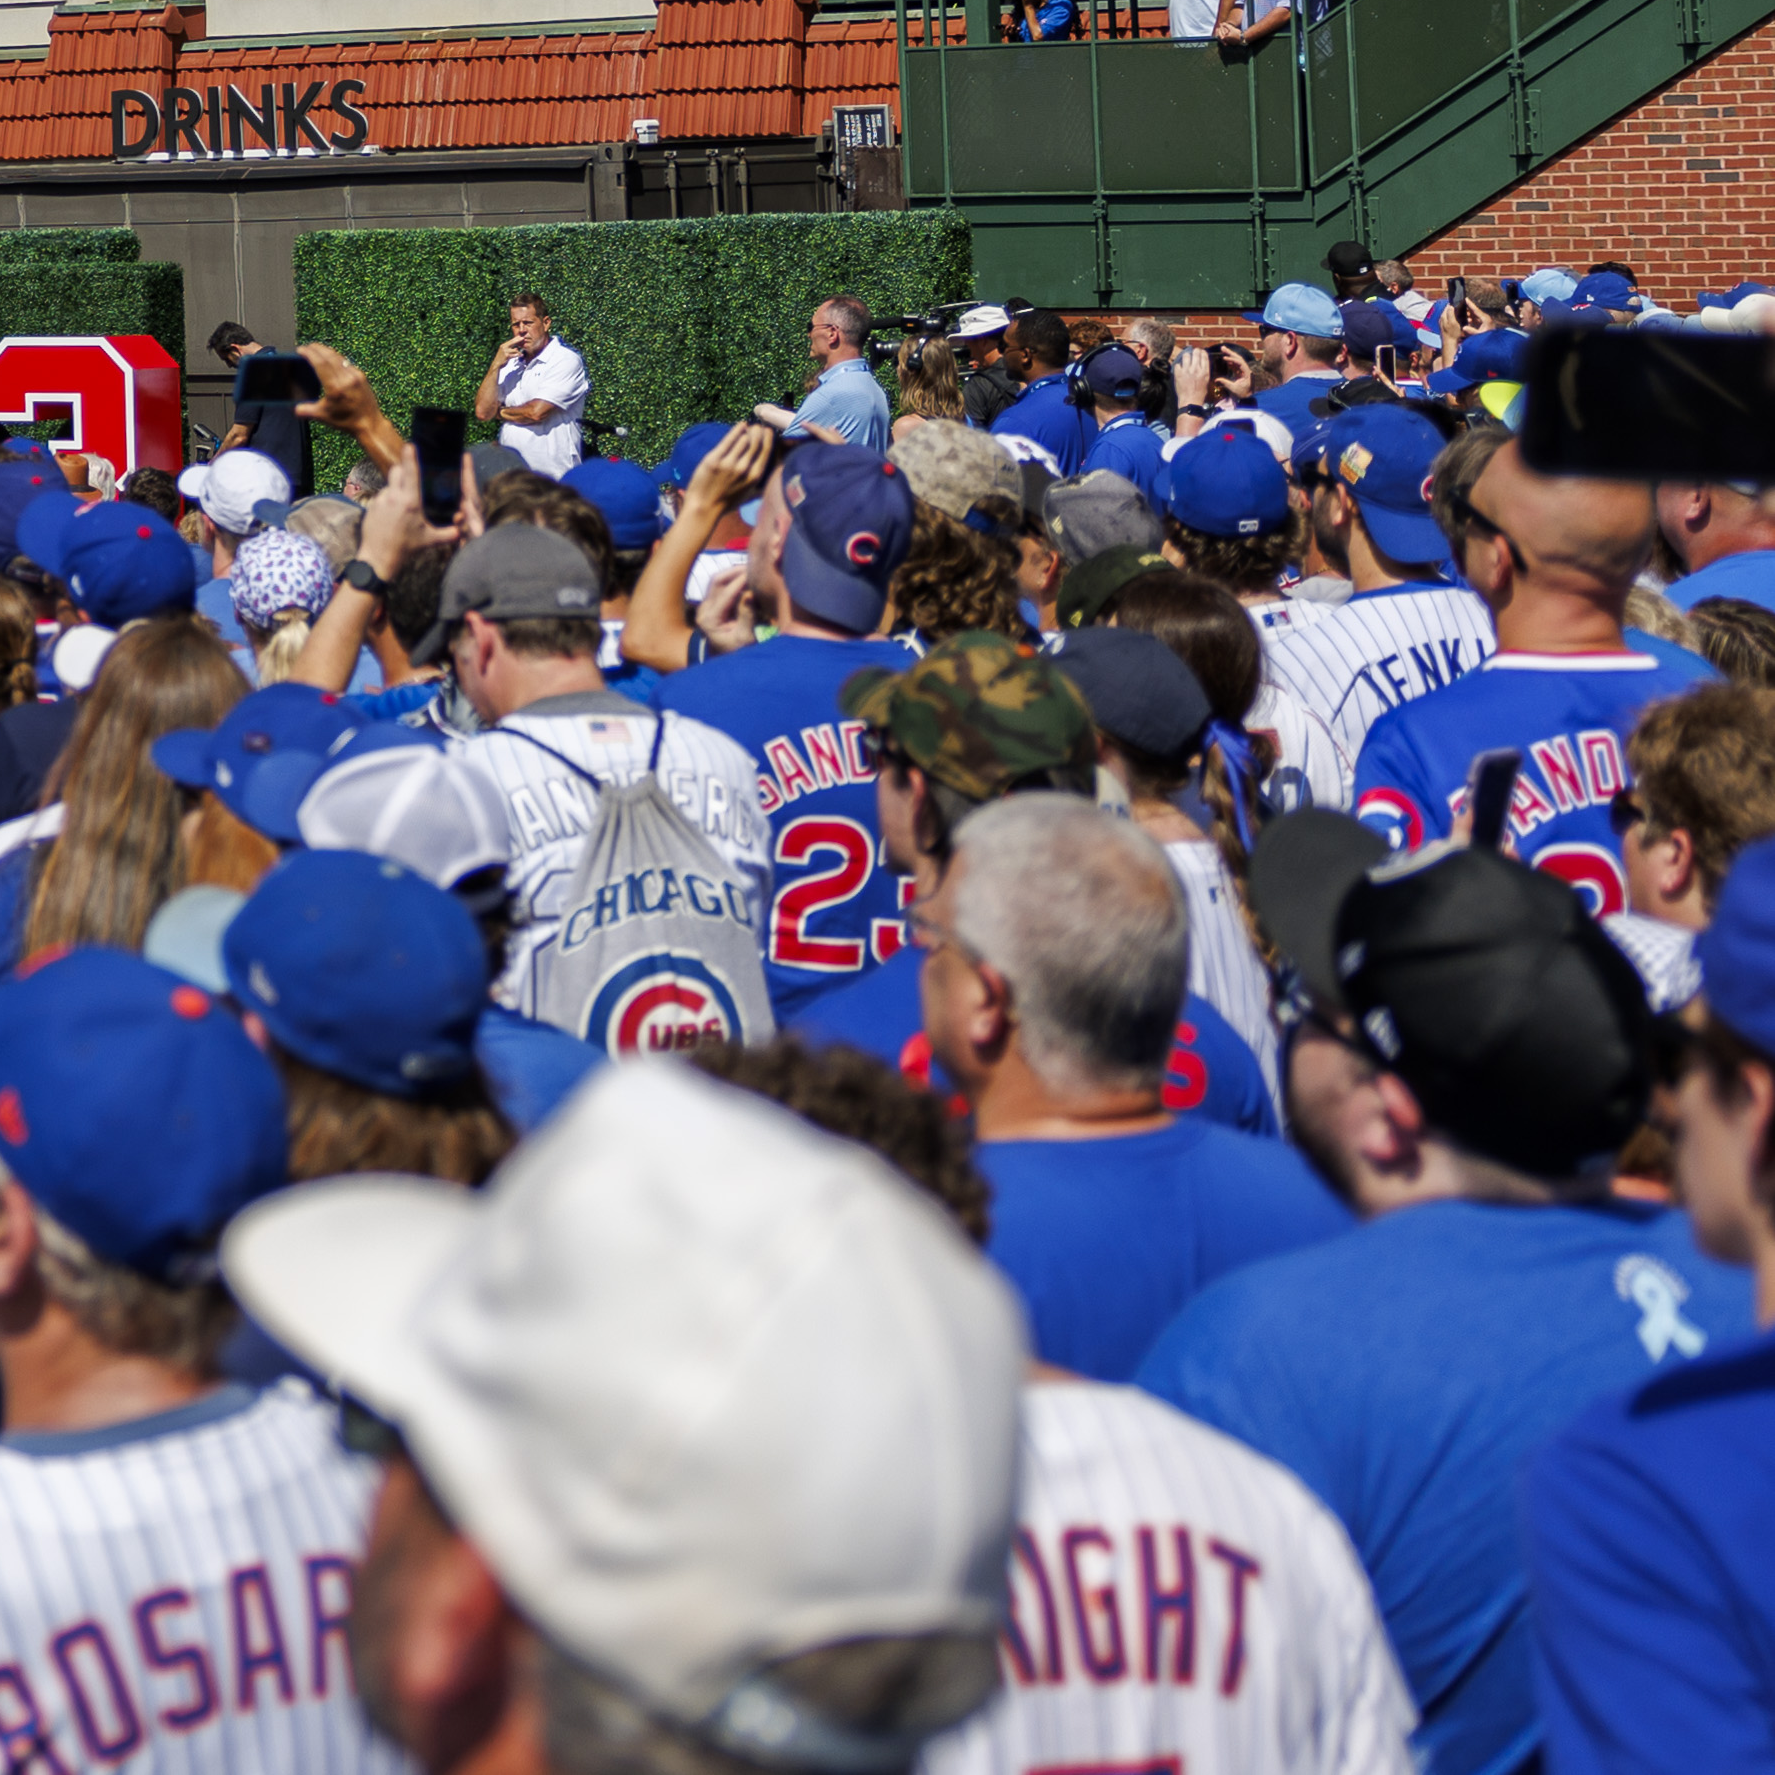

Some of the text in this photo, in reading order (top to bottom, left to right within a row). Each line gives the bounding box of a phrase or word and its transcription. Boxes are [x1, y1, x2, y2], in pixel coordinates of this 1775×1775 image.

[111, 78, 370, 159] DRINKS
[845, 530, 882, 566] C
[560, 866, 754, 954] CHICAGO
